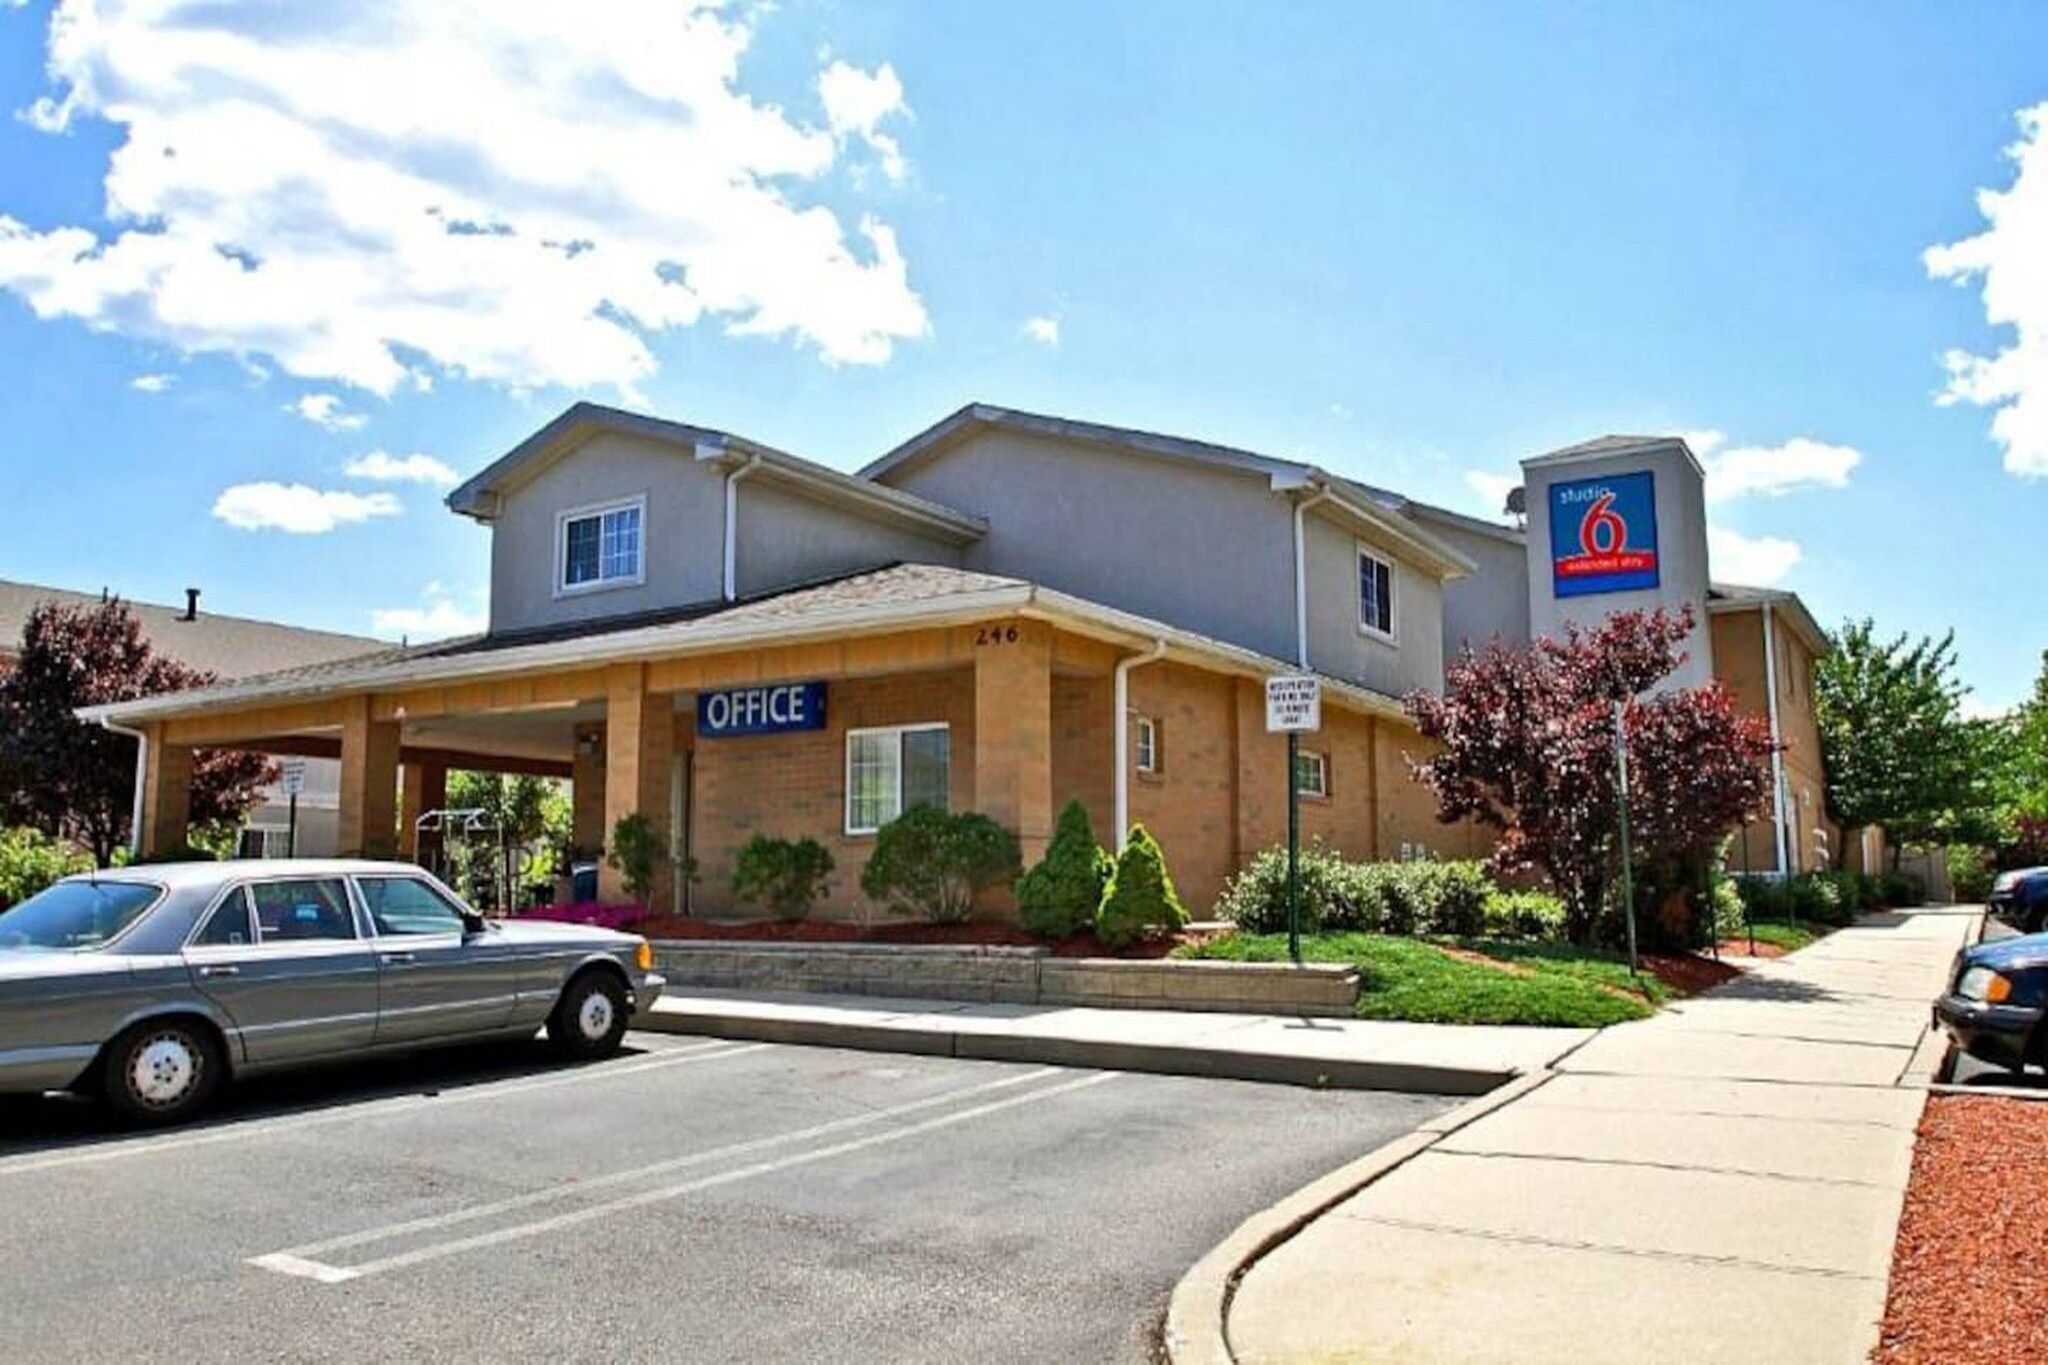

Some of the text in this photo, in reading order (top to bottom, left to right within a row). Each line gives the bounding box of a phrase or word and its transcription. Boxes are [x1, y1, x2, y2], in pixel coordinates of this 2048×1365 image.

[1560, 485, 1610, 505] studio
[1579, 492, 1627, 556] 6
[976, 626, 1018, 645] 246
[707, 686, 805, 729] OFFICE
